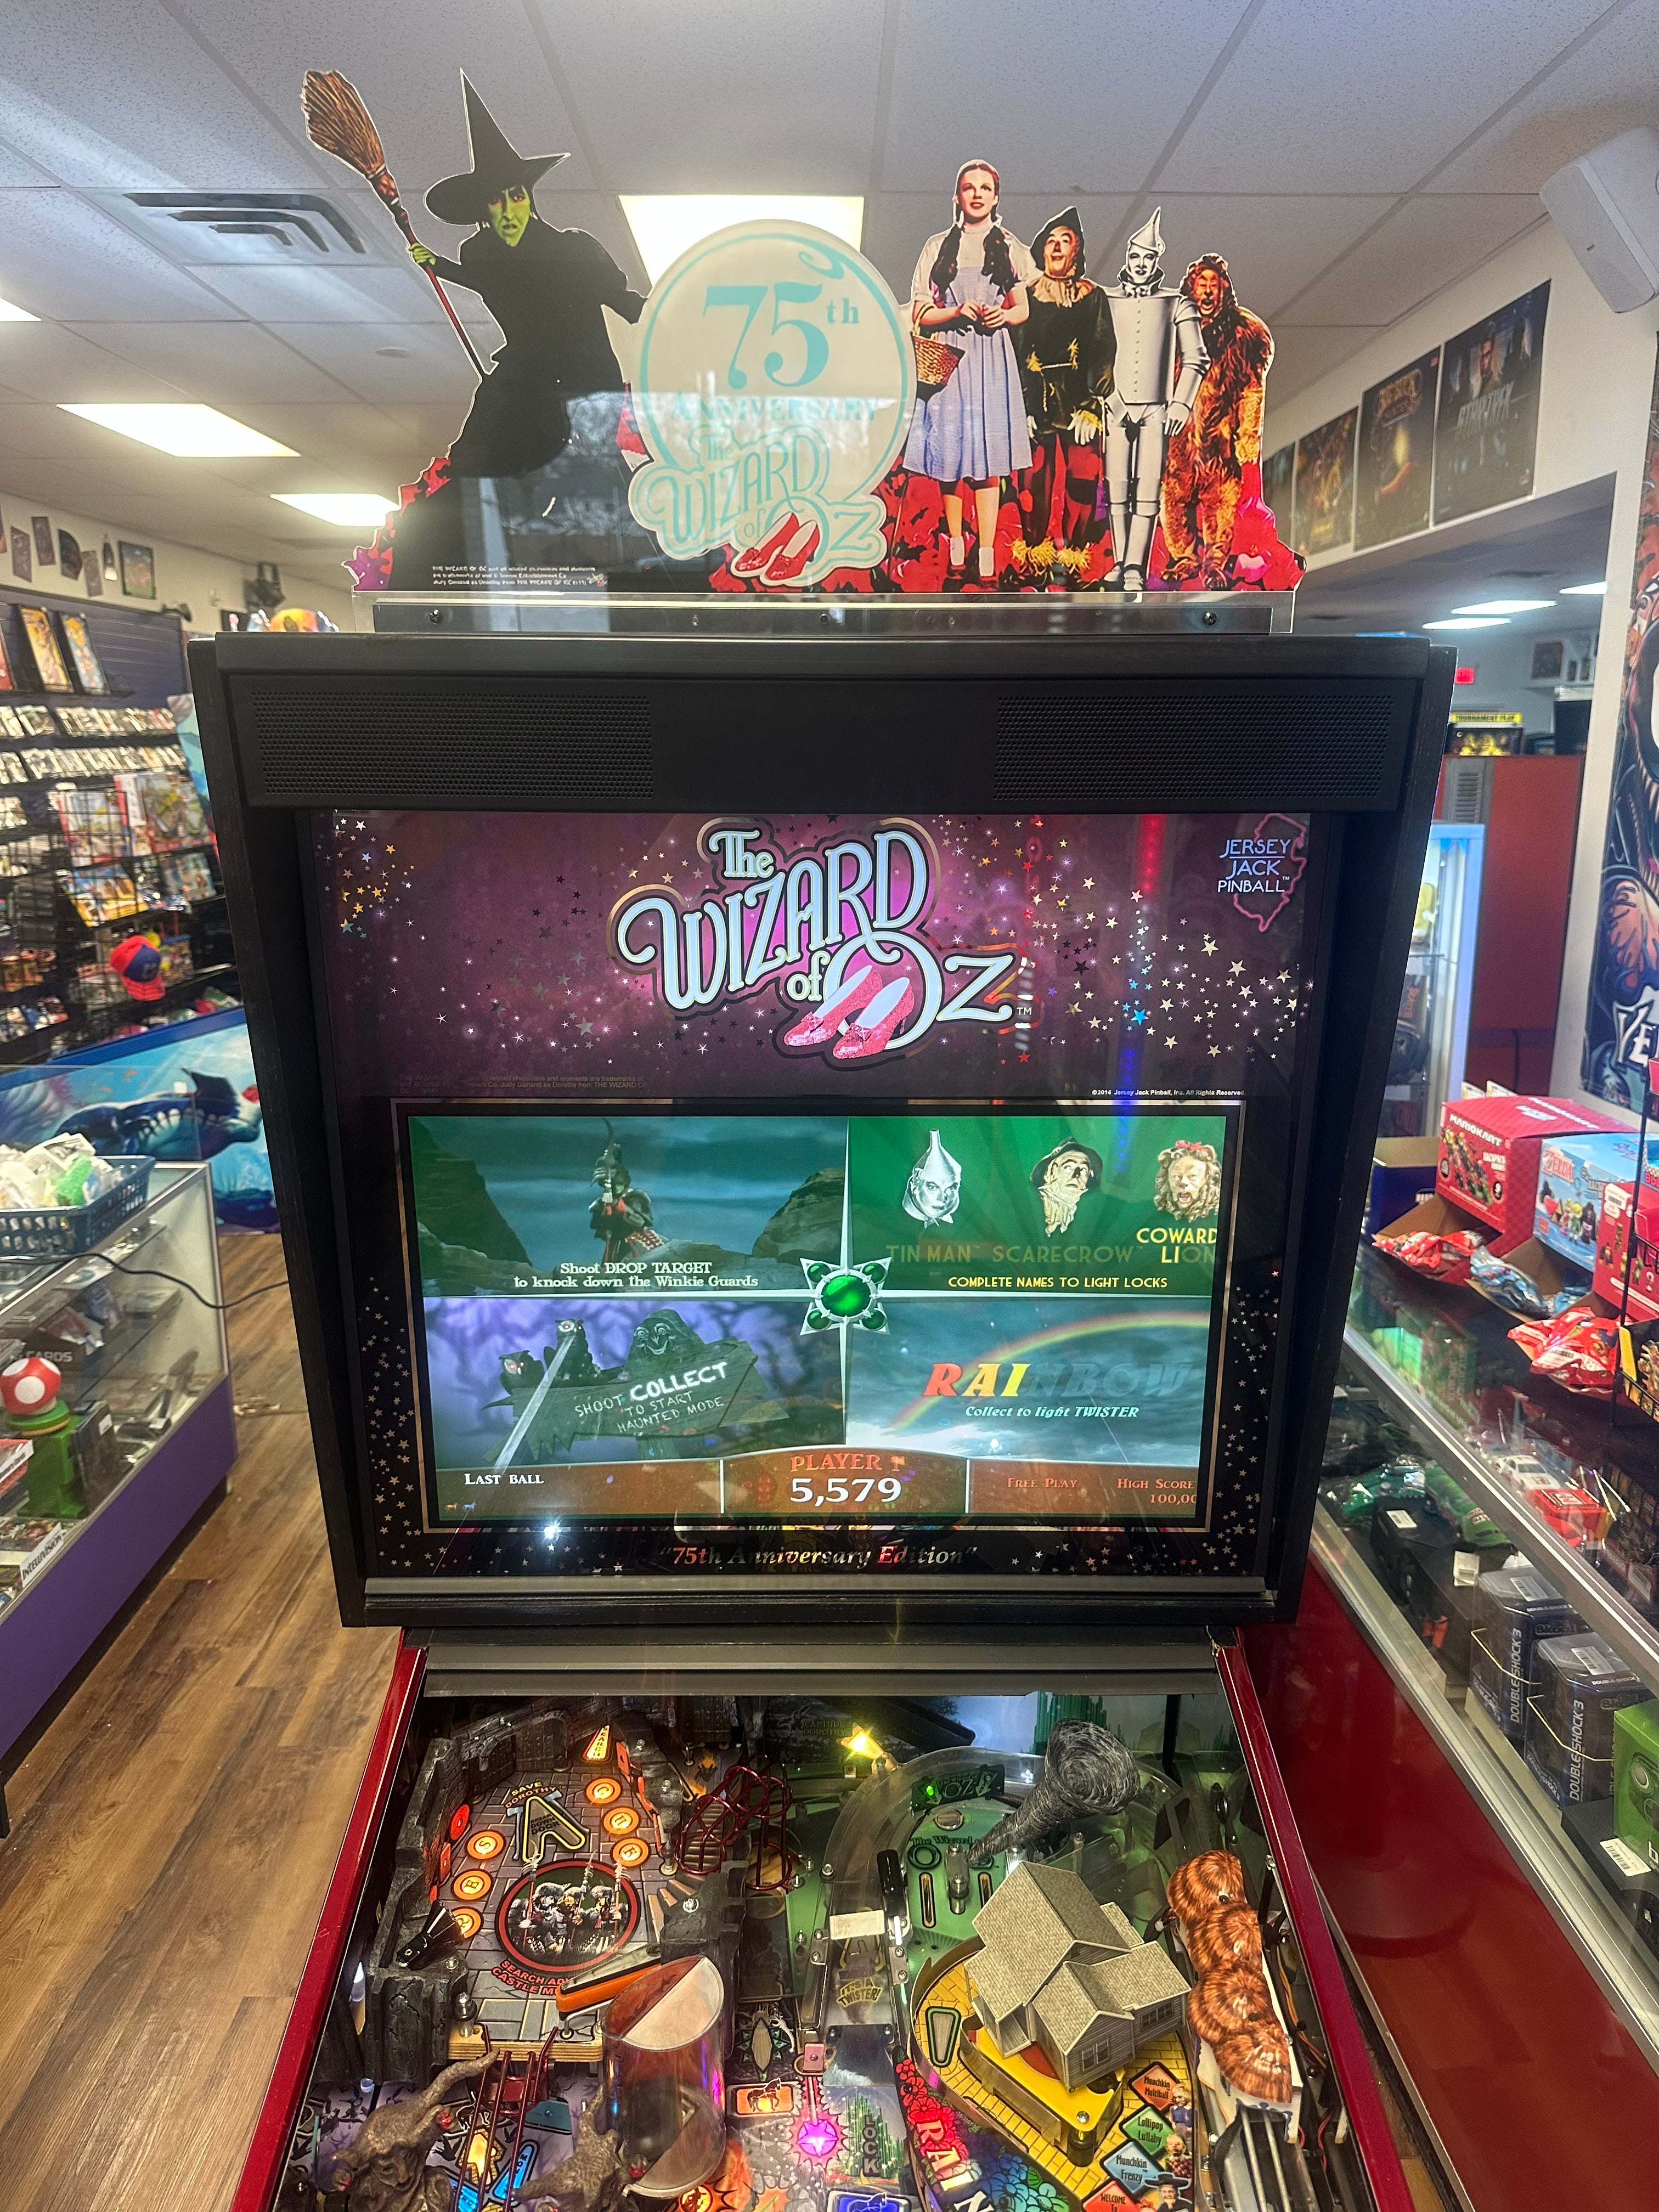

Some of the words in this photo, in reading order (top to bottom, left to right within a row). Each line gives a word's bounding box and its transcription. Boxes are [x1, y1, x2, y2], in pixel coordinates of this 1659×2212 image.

[702, 281, 860, 390] 75th
[708, 830, 774, 878] The
[1219, 839, 1291, 859] JERSEY
[1226, 860, 1281, 880] JACK
[1217, 879, 1285, 893] PINBALL
[618, 832, 926, 1010] WIZARD
[785, 950, 831, 1001] of
[927, 1245, 971, 1262] MAN
[992, 1246, 1132, 1263] SCARECROW
[560, 1262, 601, 1274] Shoot
[604, 1262, 648, 1274] DROP
[651, 1262, 712, 1274] TARGET
[514, 1276, 528, 1288] to
[532, 1276, 579, 1288] knock
[583, 1276, 624, 1287] down
[628, 1276, 651, 1287] the
[654, 1276, 704, 1287] Winkie
[708, 1276, 759, 1287] Guards
[948, 1277, 1012, 1288] COMPLETE
[1016, 1277, 1054, 1288] NAMES
[1059, 1277, 1080, 1287] TO
[1084, 1277, 1120, 1288] LIGHT
[1124, 1277, 1168, 1288] LOCKS
[575, 1394, 623, 1417] SHOOT
[630, 1362, 727, 1401] COLLECT
[624, 1404, 645, 1417] TO
[650, 1391, 693, 1411] START
[966, 1406, 1014, 1417] Collect
[1017, 1407, 1031, 1417] to
[1035, 1406, 1071, 1419] light
[1074, 1407, 1140, 1418] TWISTER
[617, 1409, 680, 1432] HAUNTED
[687, 1397, 725, 1415] MODE
[790, 1453, 882, 1471] PLAYER
[790, 1477, 901, 1507] 5,579
[1513, 1628, 1522, 1637] 3
[1574, 1699, 1584, 1711] 3
[505, 1786, 556, 1808] DOROTHY
[511, 1781, 543, 1796] SAVE
[492, 1967, 539, 1993] CASTLE
[501, 1961, 544, 1984] SEARCH
[838, 1987, 881, 2006] TWISTER!
[1144, 2076, 1170, 2088] Munchkin
[1145, 2087, 1169, 2099] Multiball
[1138, 2116, 1163, 2132] Lollipop
[864, 2116, 880, 2174] LOCK
[1138, 2130, 1162, 2146] Lullaby
[1116, 2154, 1148, 2169] Munchkin
[1121, 2169, 1142, 2184] Frenzy
[1101, 2193, 1126, 2204] WELCOME
